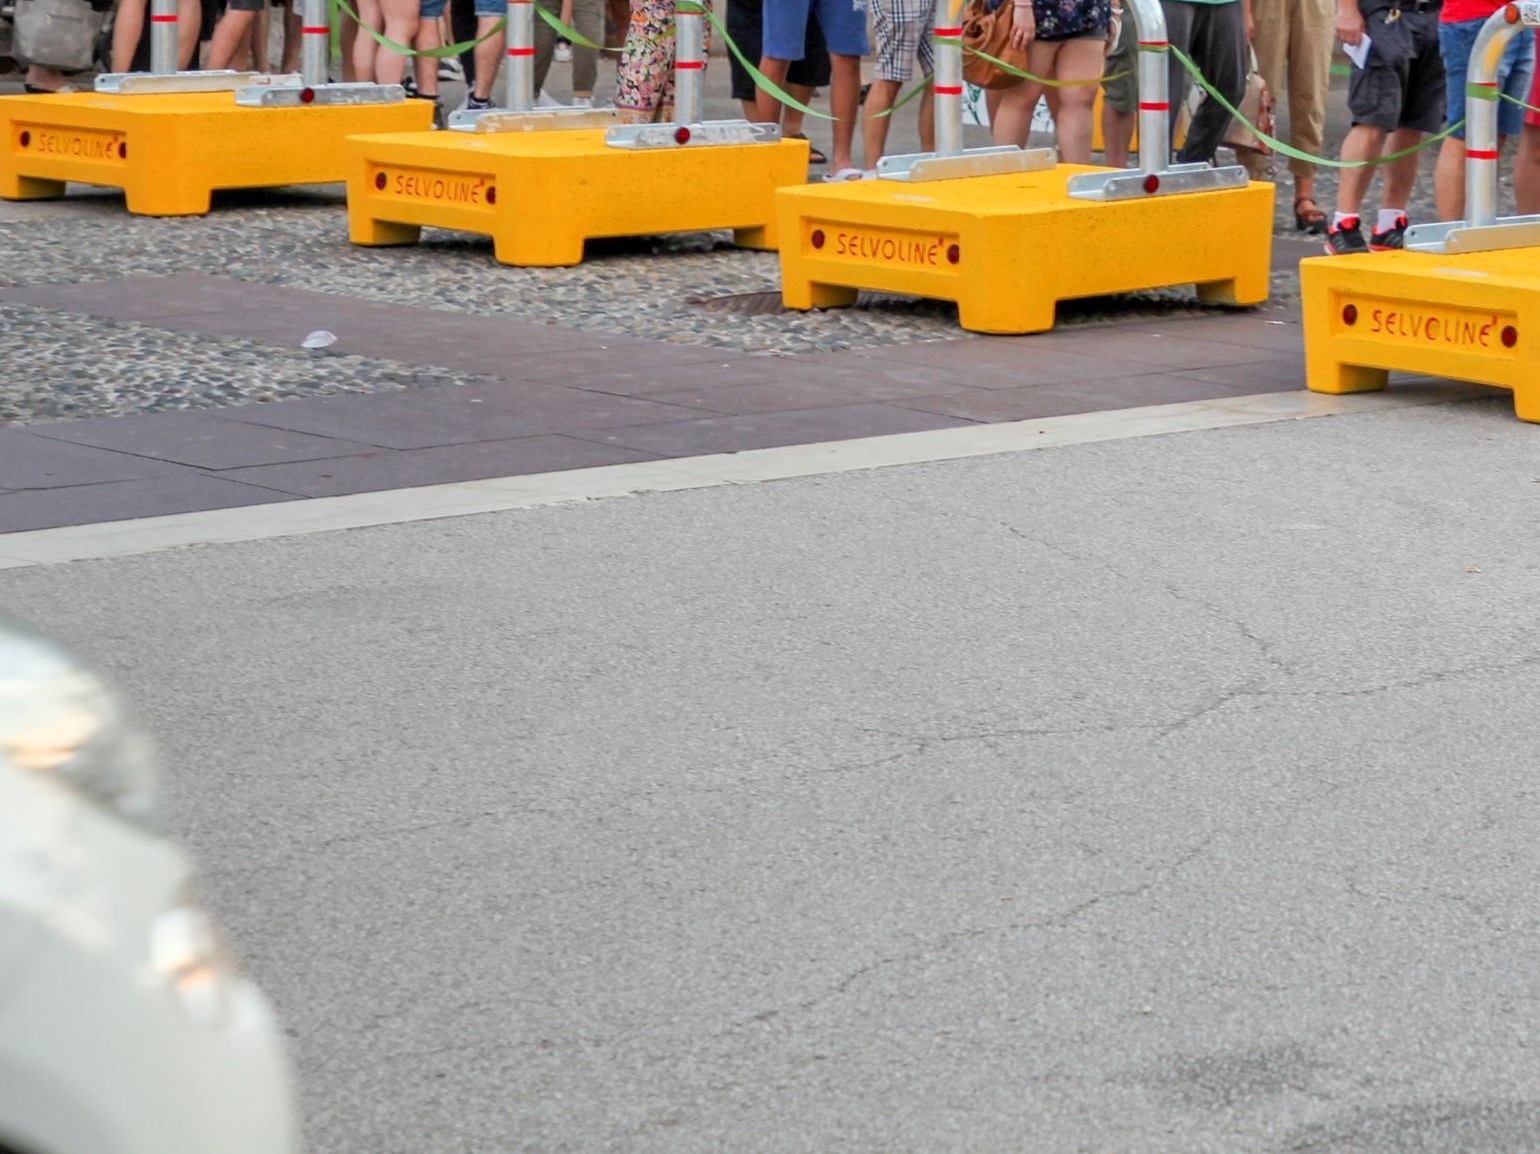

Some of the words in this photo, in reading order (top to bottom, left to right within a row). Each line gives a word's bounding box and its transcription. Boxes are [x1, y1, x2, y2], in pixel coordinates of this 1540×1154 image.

[395, 175, 480, 204] SELVOLINE
[836, 232, 938, 265] SELVOLINE
[1370, 309, 1492, 347] SELVOLINE
